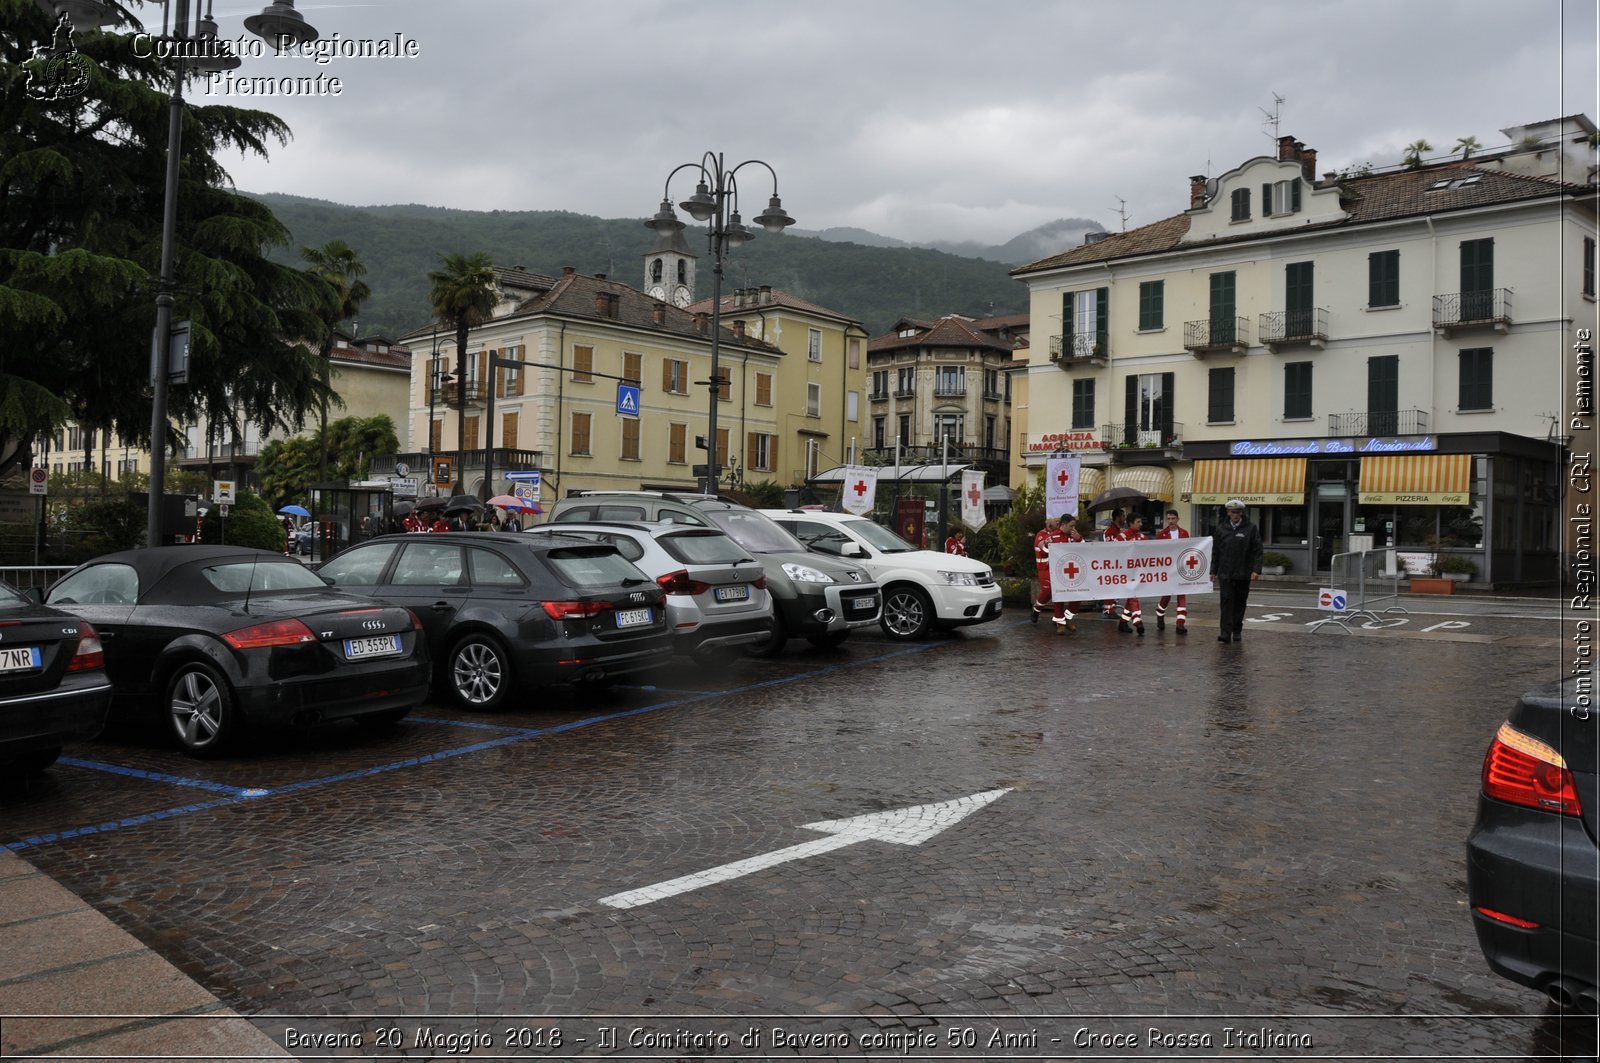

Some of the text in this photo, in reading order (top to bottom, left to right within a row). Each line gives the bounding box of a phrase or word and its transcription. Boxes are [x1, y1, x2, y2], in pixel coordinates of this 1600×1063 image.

[1042, 433, 1093, 442] AGENZIA
[1232, 441, 1320, 455] Ristorante
[1324, 441, 1354, 453] Bar
[1090, 556, 1173, 571] C.R.I. BAVENO
[1096, 574, 1128, 586] 1968
[1139, 571, 1169, 584] 2018
[352, 635, 396, 654] ED 353PK
